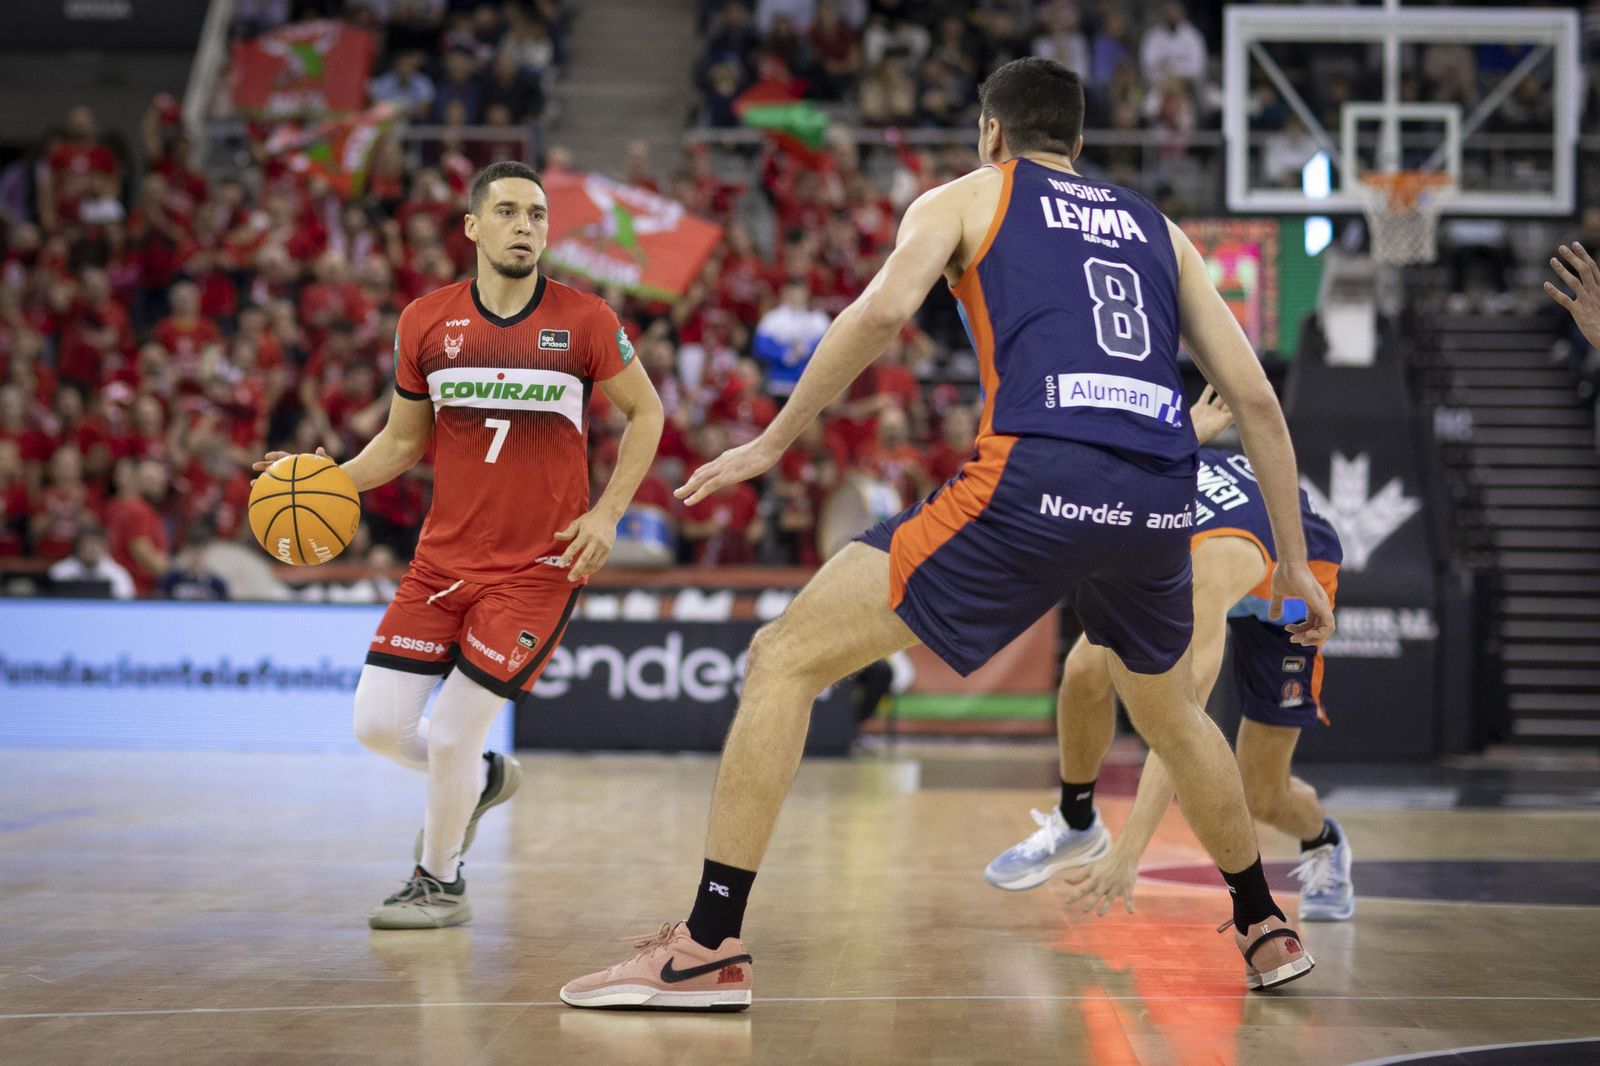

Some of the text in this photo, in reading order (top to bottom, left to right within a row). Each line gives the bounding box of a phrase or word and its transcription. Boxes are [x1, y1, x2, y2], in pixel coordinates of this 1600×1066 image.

[1040, 195, 1148, 243] LEYMA
[445, 318, 471, 328] vive
[1083, 256, 1151, 361] 8
[440, 380, 567, 402] COVIRAN
[1045, 375, 1055, 409] Grupo
[1070, 379, 1150, 410] Aluman
[484, 417, 512, 464] 7
[1197, 460, 1250, 512] LEYM
[1040, 493, 1134, 526] Nordés
[519, 636, 534, 648] acb
[530, 632, 748, 701] ende
